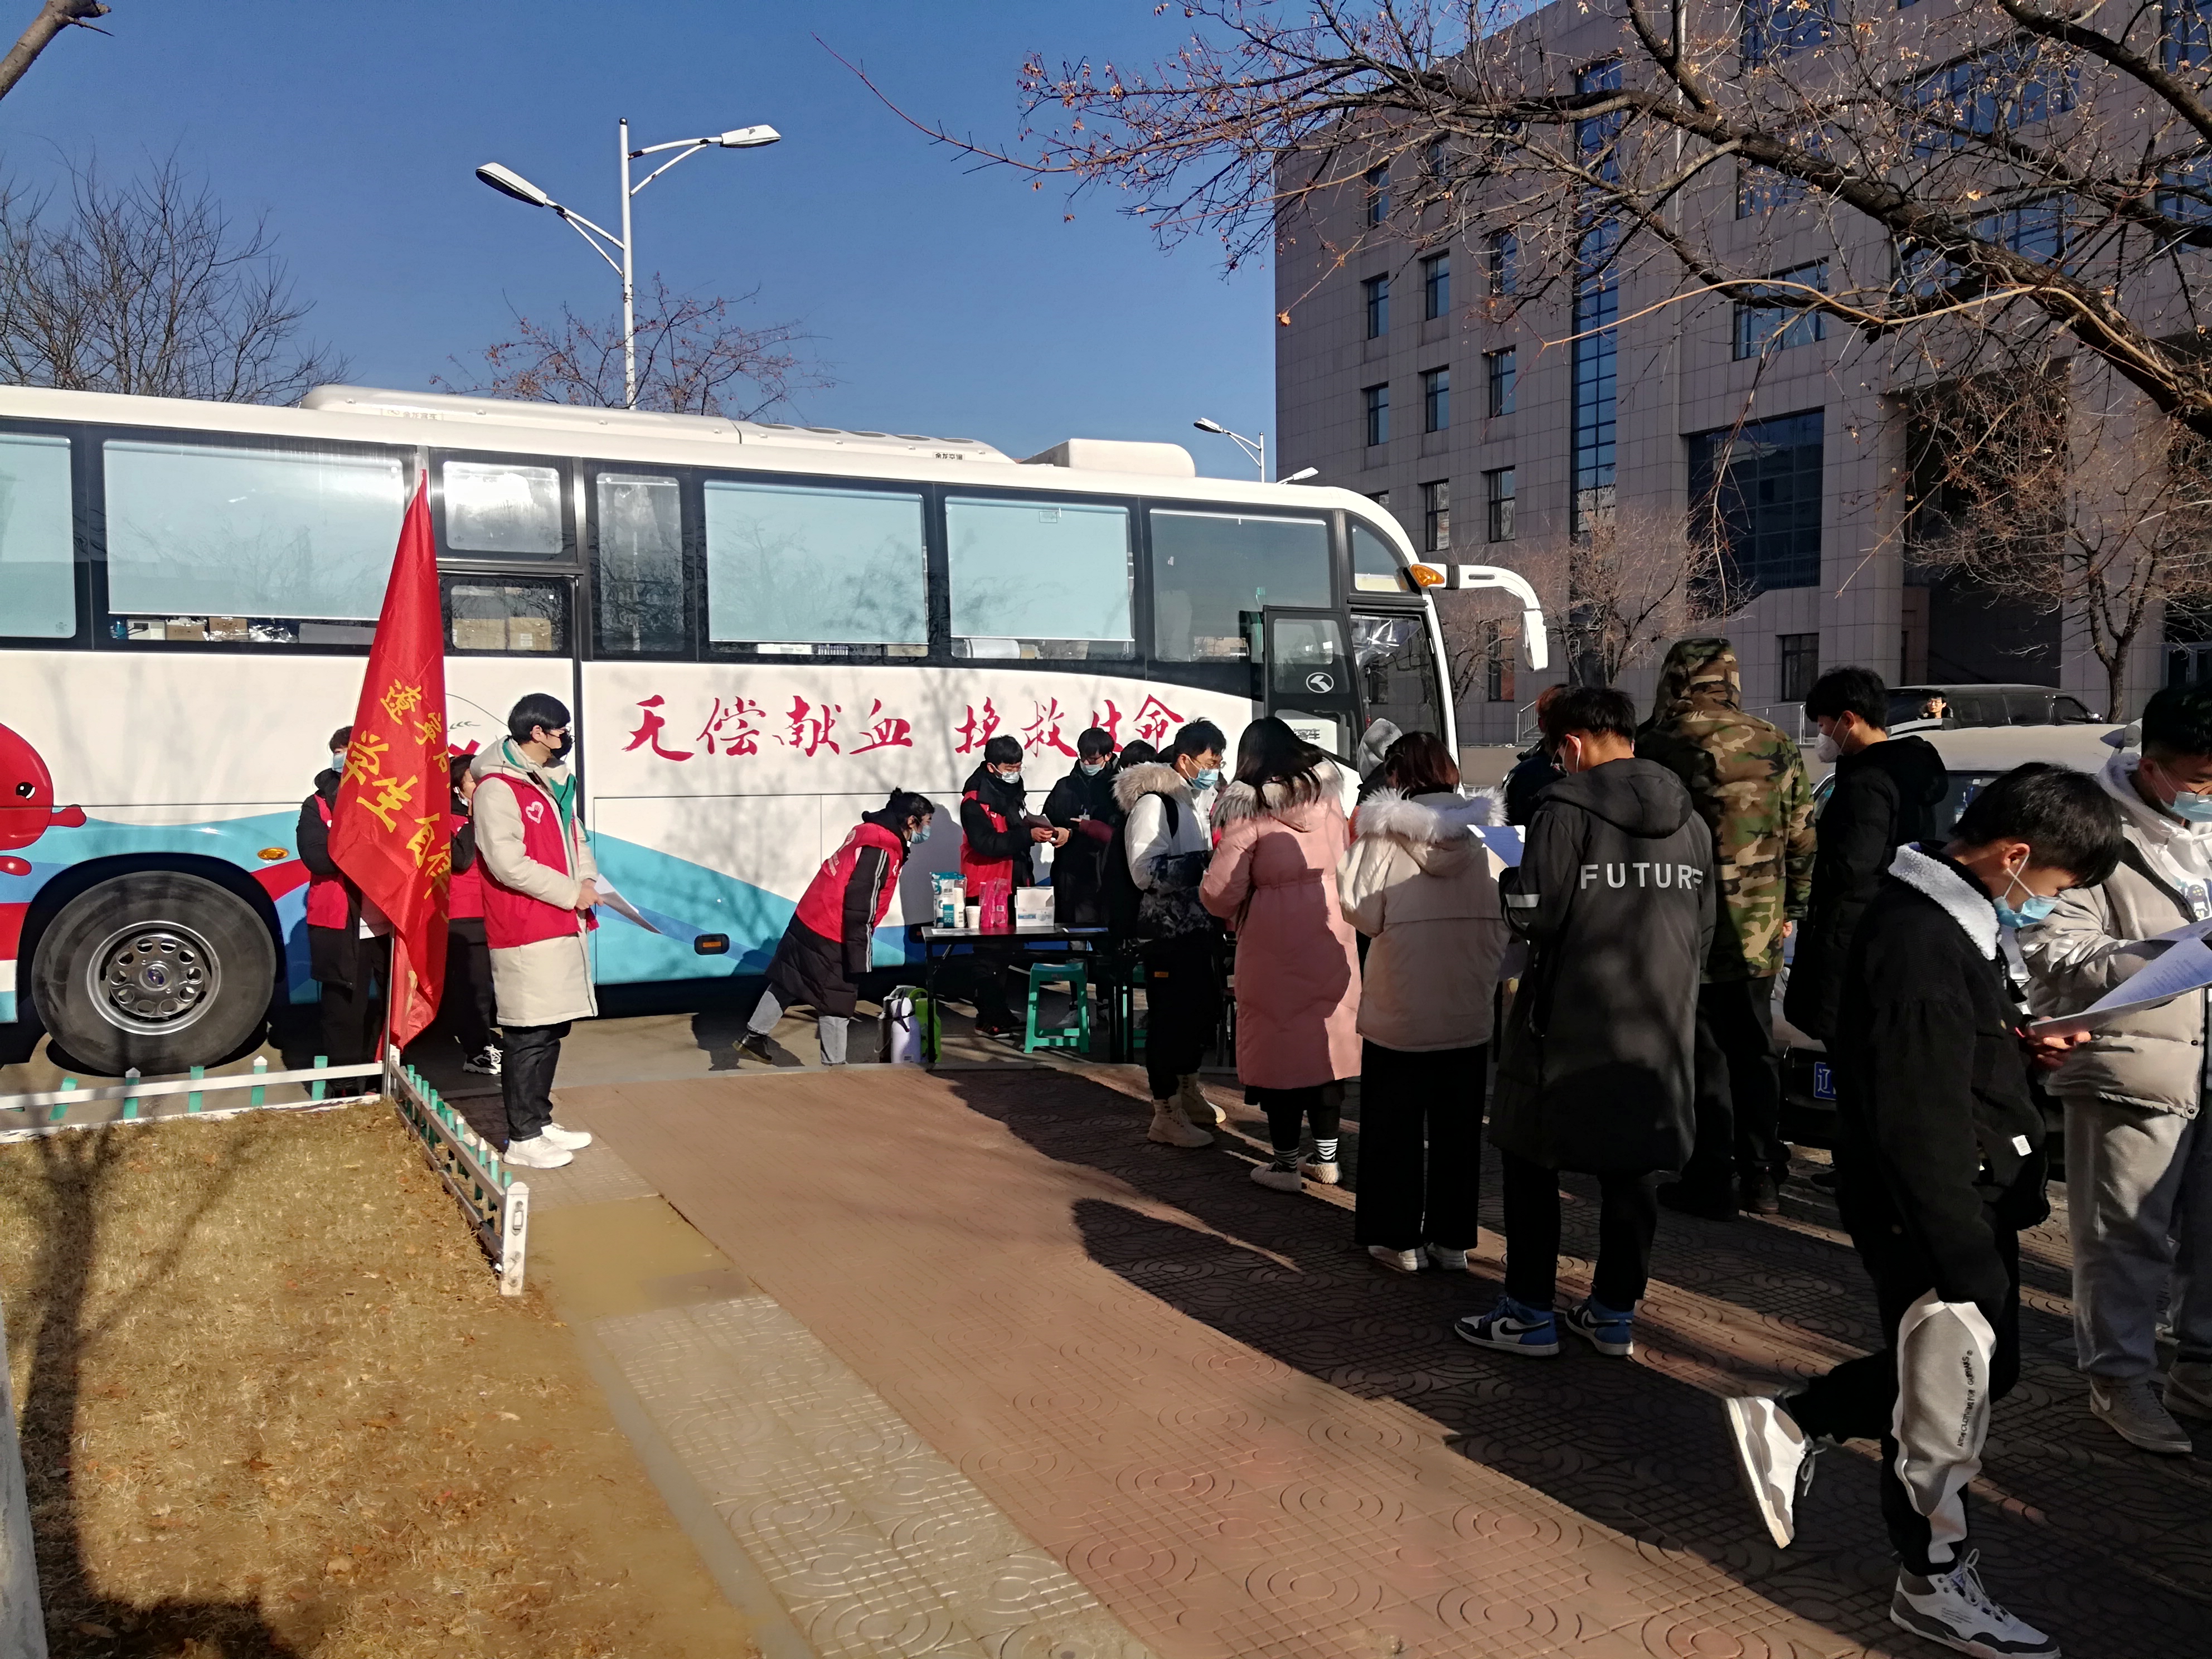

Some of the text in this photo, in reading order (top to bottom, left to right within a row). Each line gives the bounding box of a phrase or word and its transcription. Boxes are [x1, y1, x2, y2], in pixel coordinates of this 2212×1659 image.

[380, 678, 451, 788] 遼寧石
[622, 694, 913, 761] 无偿献血
[1293, 728, 1321, 740] 客车
[340, 730, 451, 923] 学生自律
[1817, 1068, 1836, 1094] 辽
